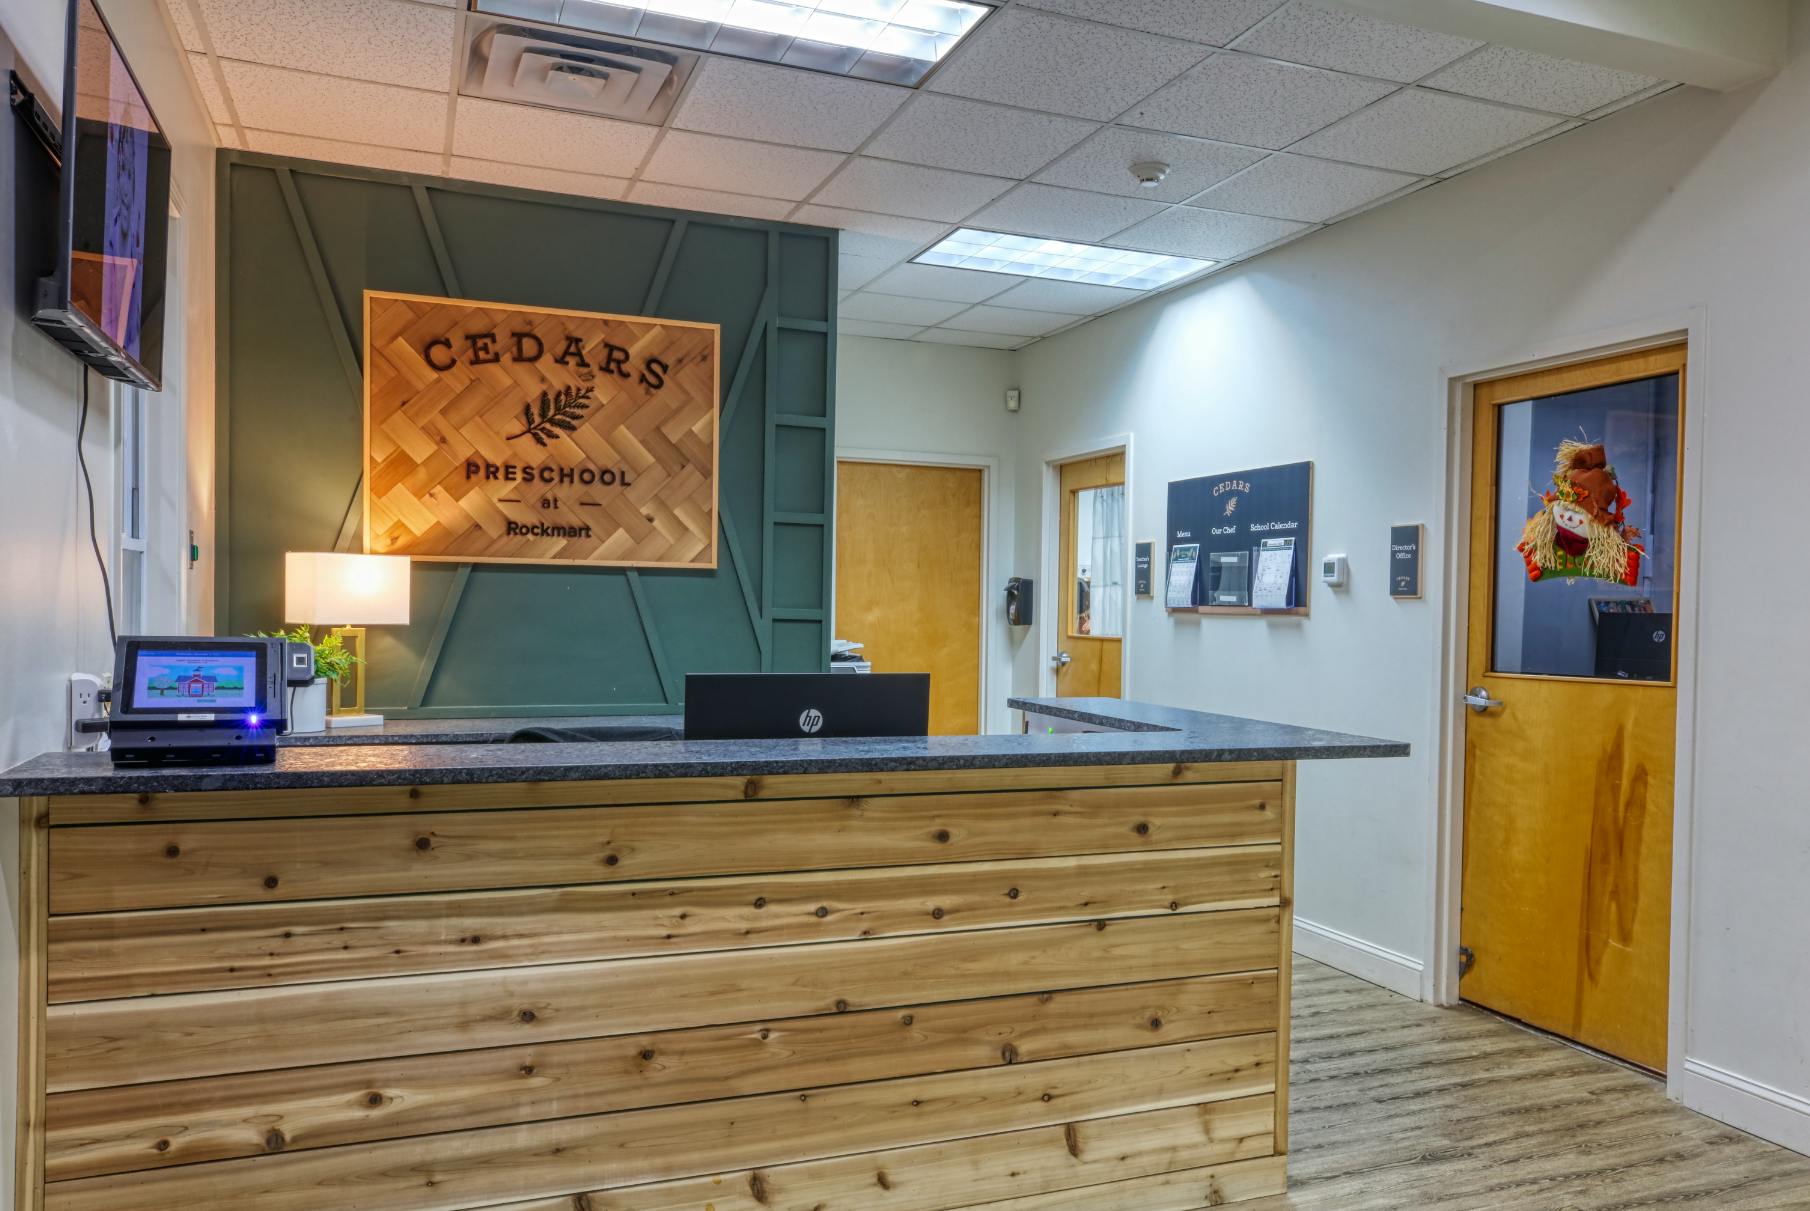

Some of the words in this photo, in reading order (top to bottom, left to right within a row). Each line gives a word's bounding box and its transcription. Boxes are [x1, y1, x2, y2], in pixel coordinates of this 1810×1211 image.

[423, 331, 669, 391] CEDARS
[465, 462, 632, 487] PRESCHOOL
[1213, 480, 1251, 497] CEDARS
[541, 497, 559, 510] at
[506, 521, 592, 539] Rockmart
[1176, 530, 1191, 538] Menu
[1211, 527, 1222, 535] Our
[1222, 525, 1237, 534] Chef
[1250, 522, 1270, 532] School
[1270, 521, 1298, 531] Calendar
[800, 708, 823, 733] hp
